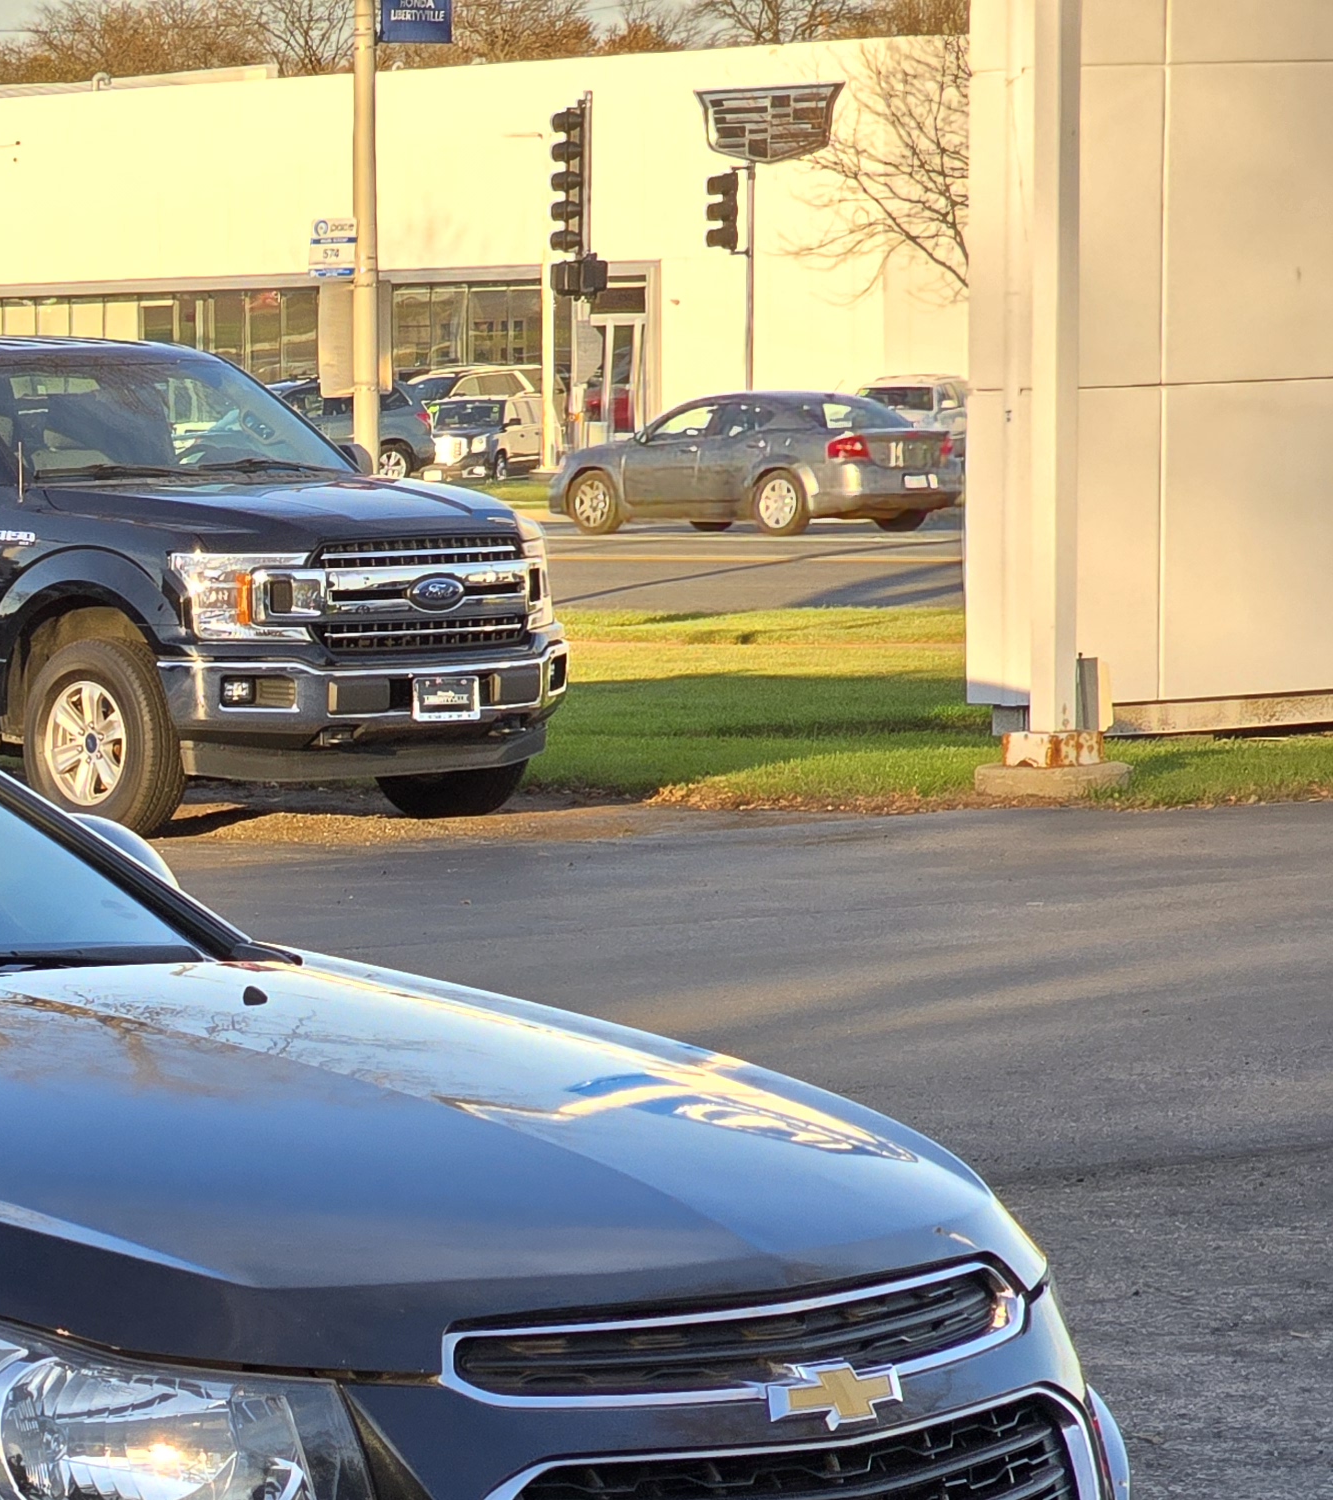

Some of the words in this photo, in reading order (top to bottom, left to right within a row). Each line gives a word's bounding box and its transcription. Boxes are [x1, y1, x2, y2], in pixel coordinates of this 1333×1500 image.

[390, 9, 445, 21] LIBERTYVILLE
[330, 223, 355, 233] pace
[322, 248, 340, 259] 574
[425, 583, 454, 598] Ford
